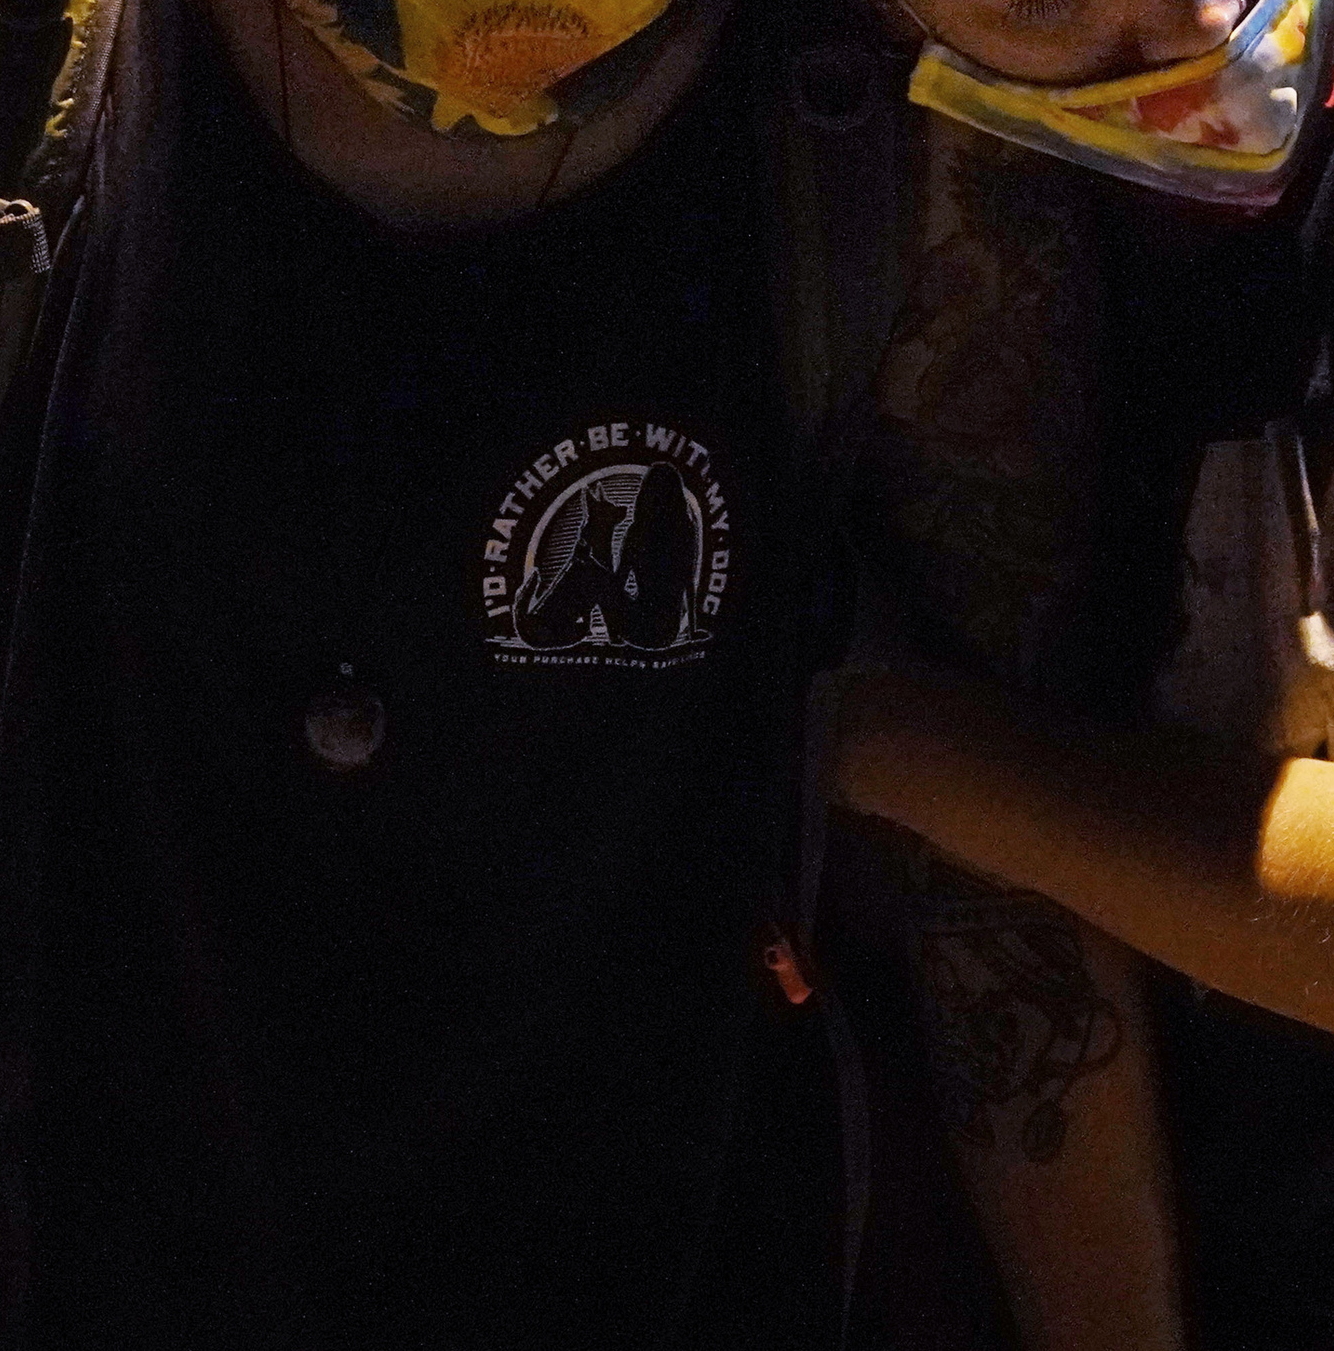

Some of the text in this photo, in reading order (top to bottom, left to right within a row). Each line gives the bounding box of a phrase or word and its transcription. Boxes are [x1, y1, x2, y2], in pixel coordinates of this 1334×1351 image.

[586, 421, 630, 452] BE
[483, 438, 580, 563] RATHER
[706, 481, 730, 531] MY
[482, 575, 511, 618] I'D
[703, 550, 730, 616] DOG
